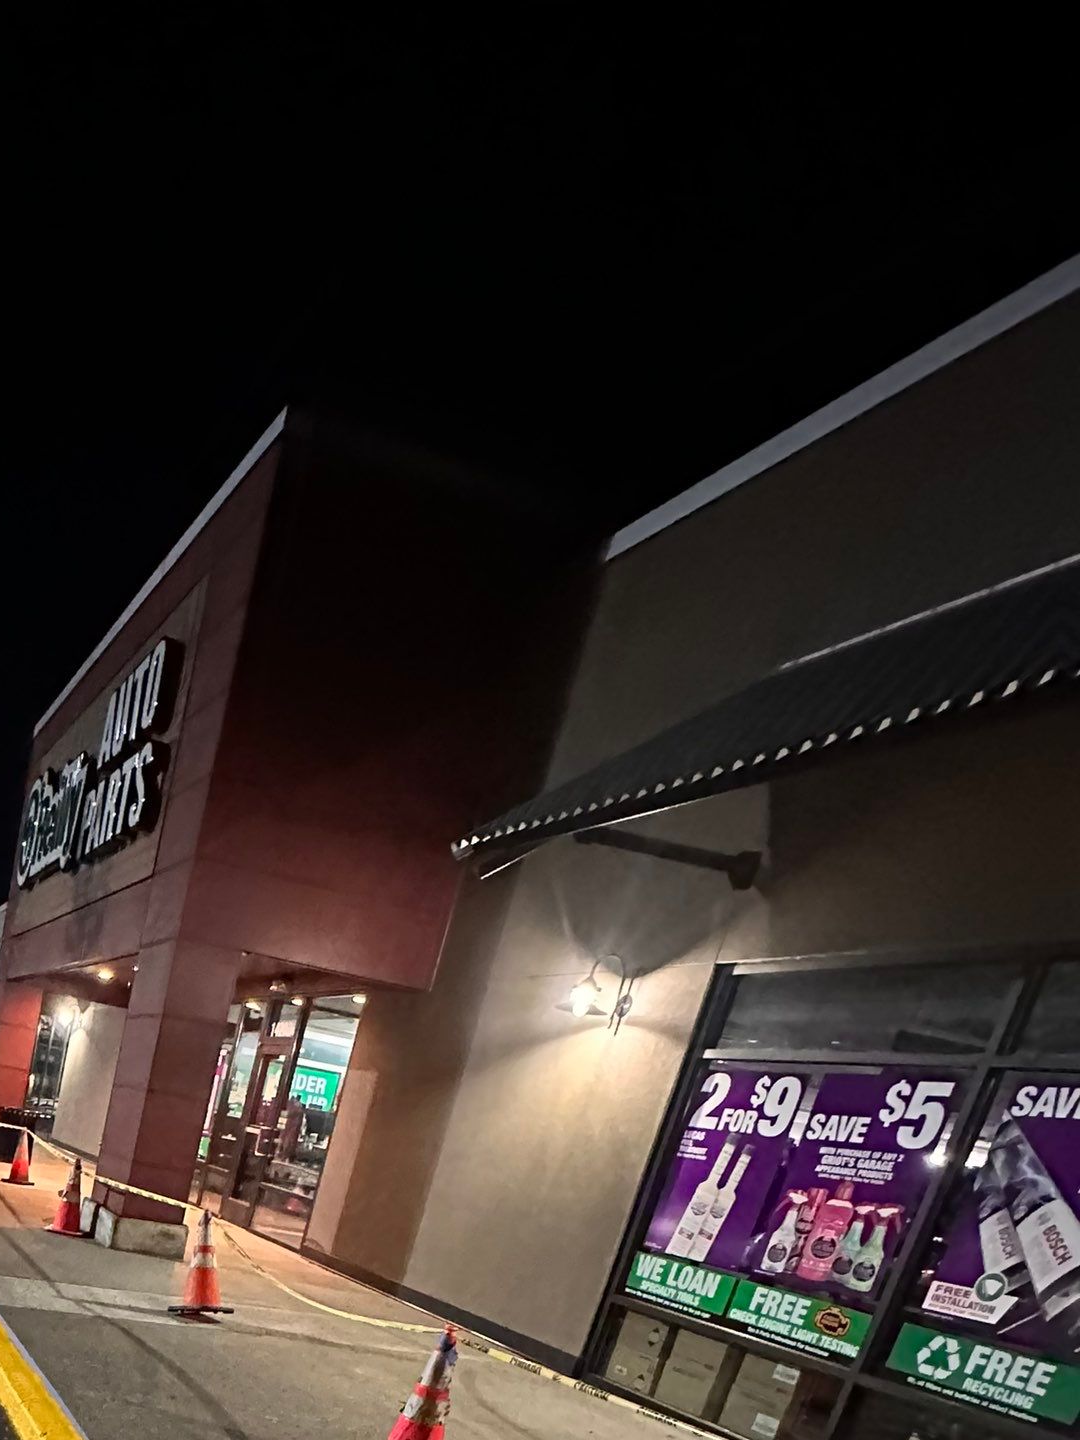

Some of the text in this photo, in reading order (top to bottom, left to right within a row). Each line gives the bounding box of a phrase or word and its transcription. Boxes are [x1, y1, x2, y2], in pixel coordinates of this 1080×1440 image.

[97, 639, 167, 770] AUTO
[76, 742, 154, 861] PARTS
[688, 1072, 802, 1138] 2 FOR $9
[806, 1079, 956, 1150] SAVE $5
[856, 1158, 896, 1172] GARAGE
[1042, 1224, 1073, 1266] BOSCH
[636, 1254, 722, 1299] WE LOAN
[934, 1283, 972, 1299] FREE
[748, 1286, 812, 1326] FREE
[930, 1293, 997, 1316] INSTALLATION
[790, 1327, 820, 1346] LIGHT
[818, 1335, 860, 1358] TESTING
[964, 1344, 1058, 1397] FREE
[962, 1377, 1035, 1410] RECYCLING
